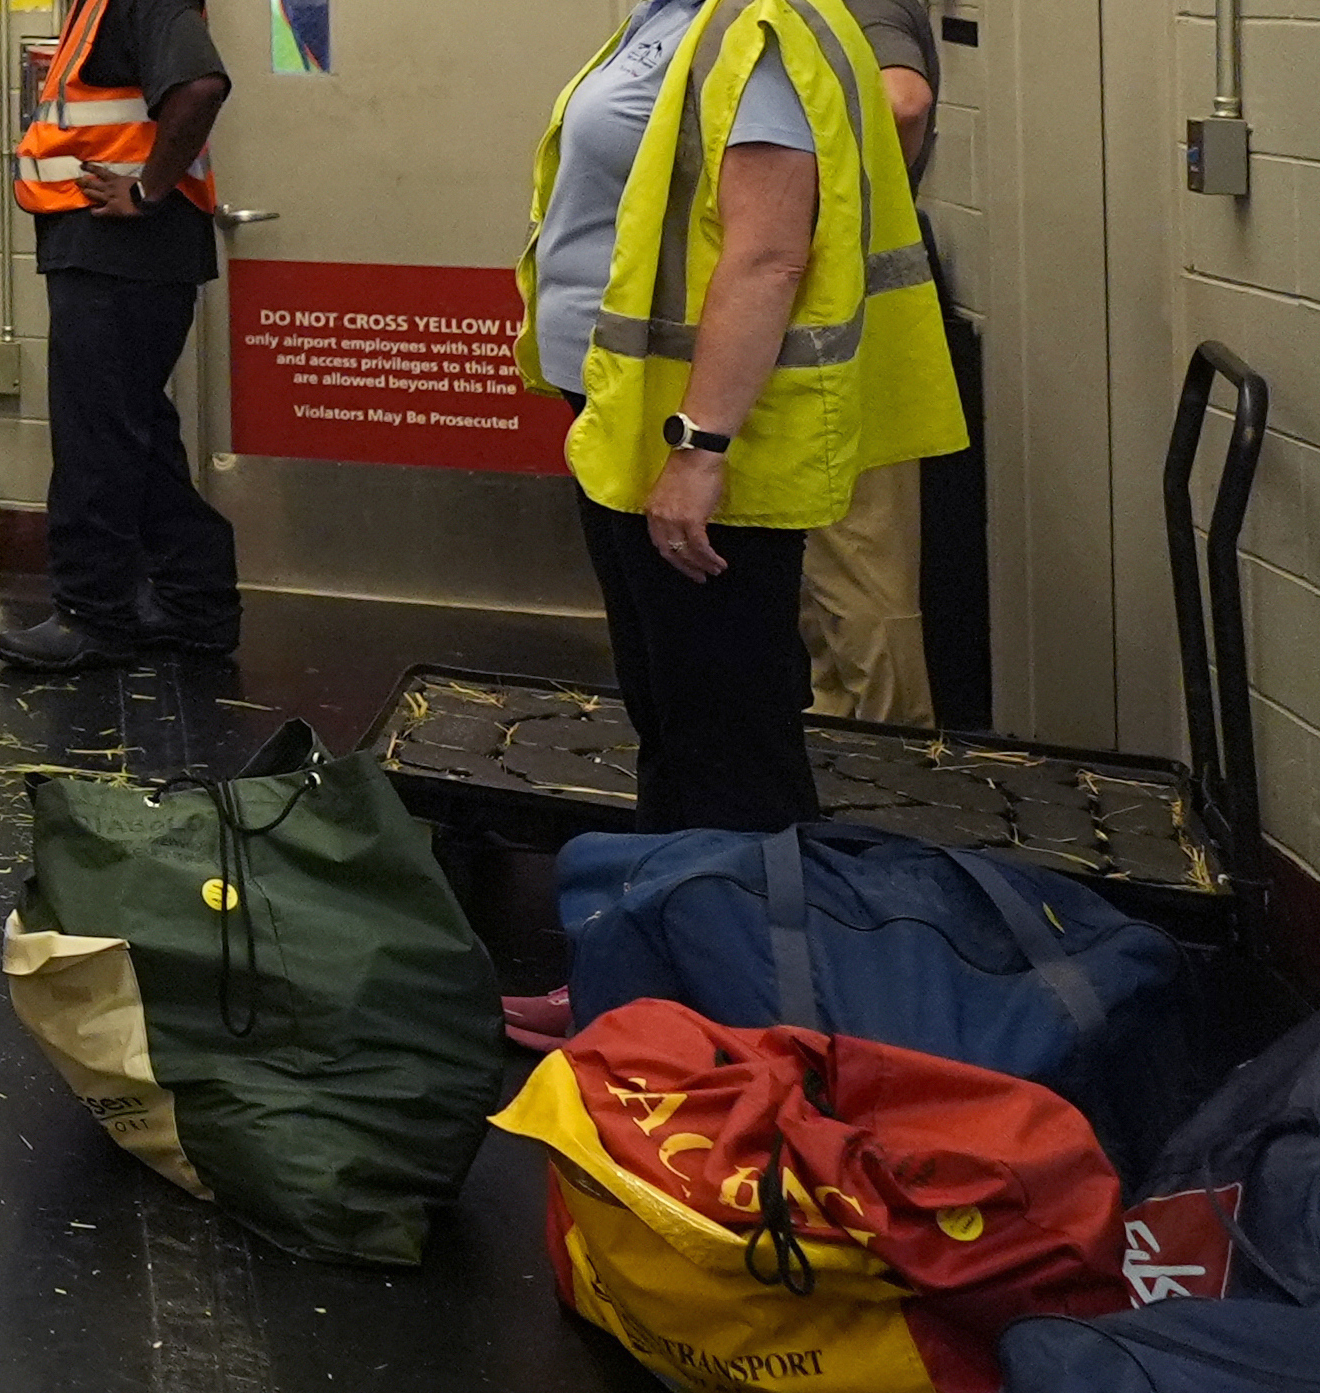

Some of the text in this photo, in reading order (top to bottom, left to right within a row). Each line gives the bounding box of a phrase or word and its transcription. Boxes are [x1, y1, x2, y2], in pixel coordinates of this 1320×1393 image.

[260, 309, 290, 326] DO
[295, 311, 338, 328] NOT
[343, 313, 408, 331] CROSS
[413, 315, 500, 335] YELLOW
[245, 334, 511, 357] only airport employees with SIDA
[276, 352, 306, 366] and
[309, 355, 357, 369] access
[361, 356, 439, 375] privileges
[443, 360, 461, 373] to
[464, 360, 494, 376] this
[293, 373, 517, 395] are allowed beyond this line
[293, 404, 519, 430] Violators May Be Prosecuted
[659, 1336, 823, 1383] TRANSPORT
